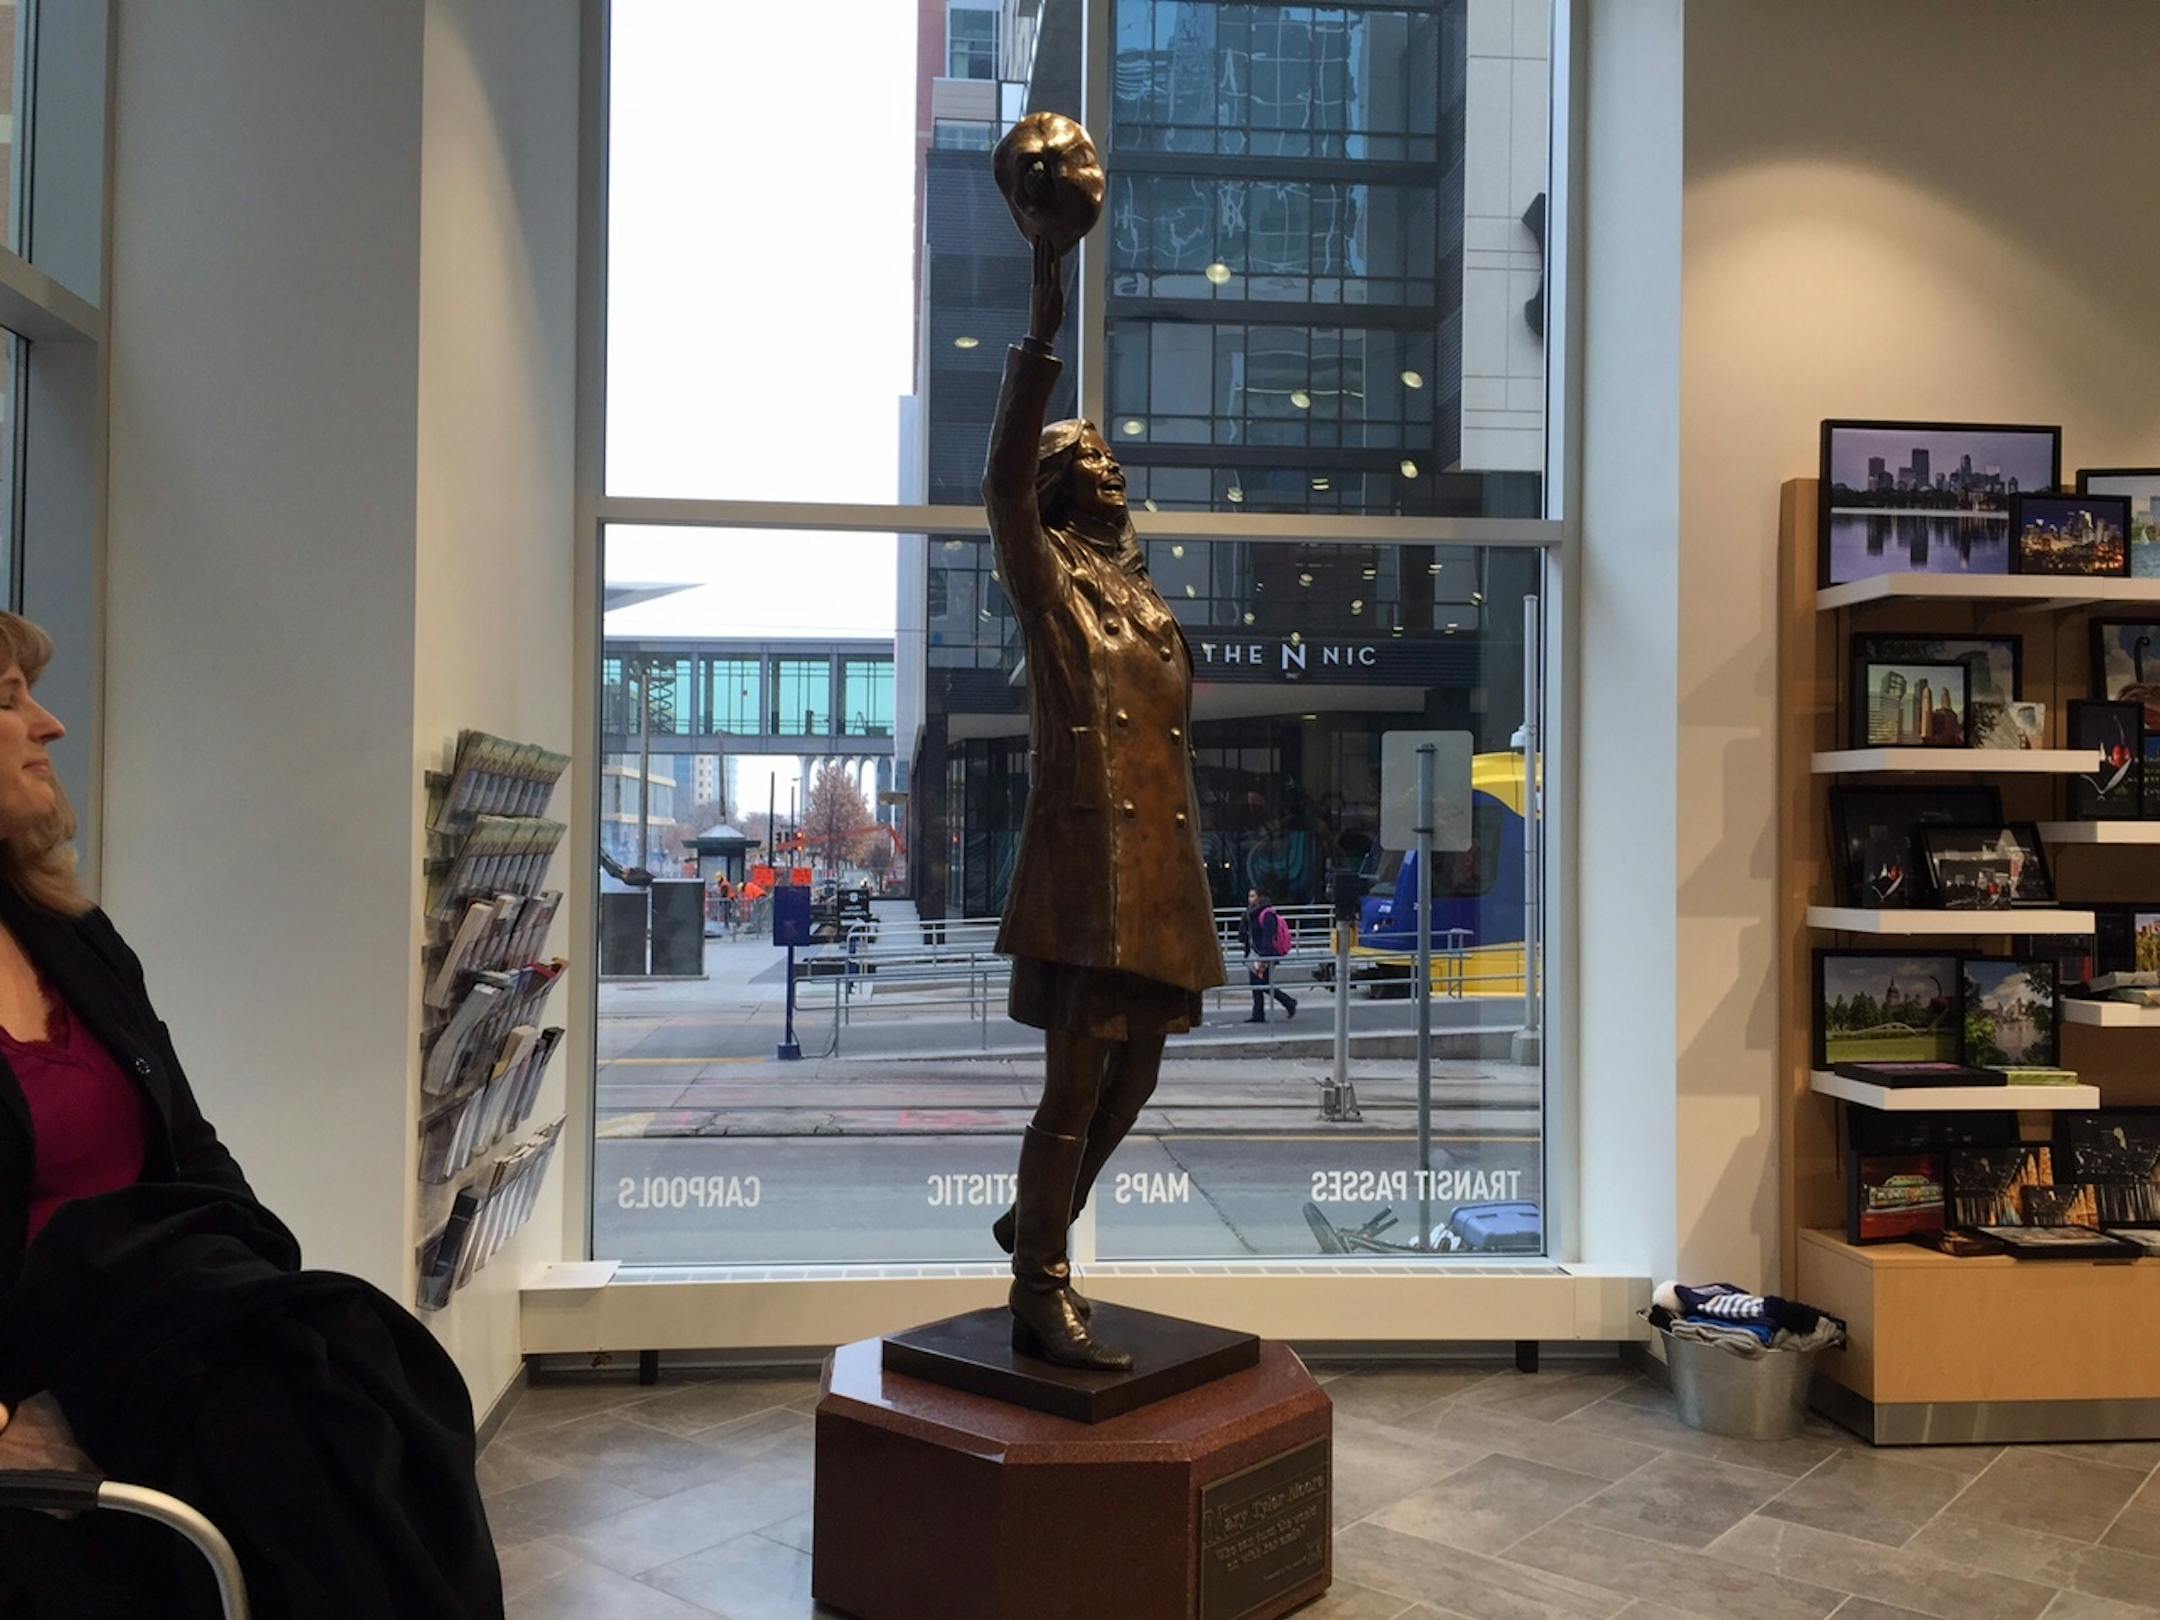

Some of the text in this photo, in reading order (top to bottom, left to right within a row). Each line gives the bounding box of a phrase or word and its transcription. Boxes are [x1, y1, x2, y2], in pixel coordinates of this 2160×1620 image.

[1202, 643, 1376, 670] THE N NIC
